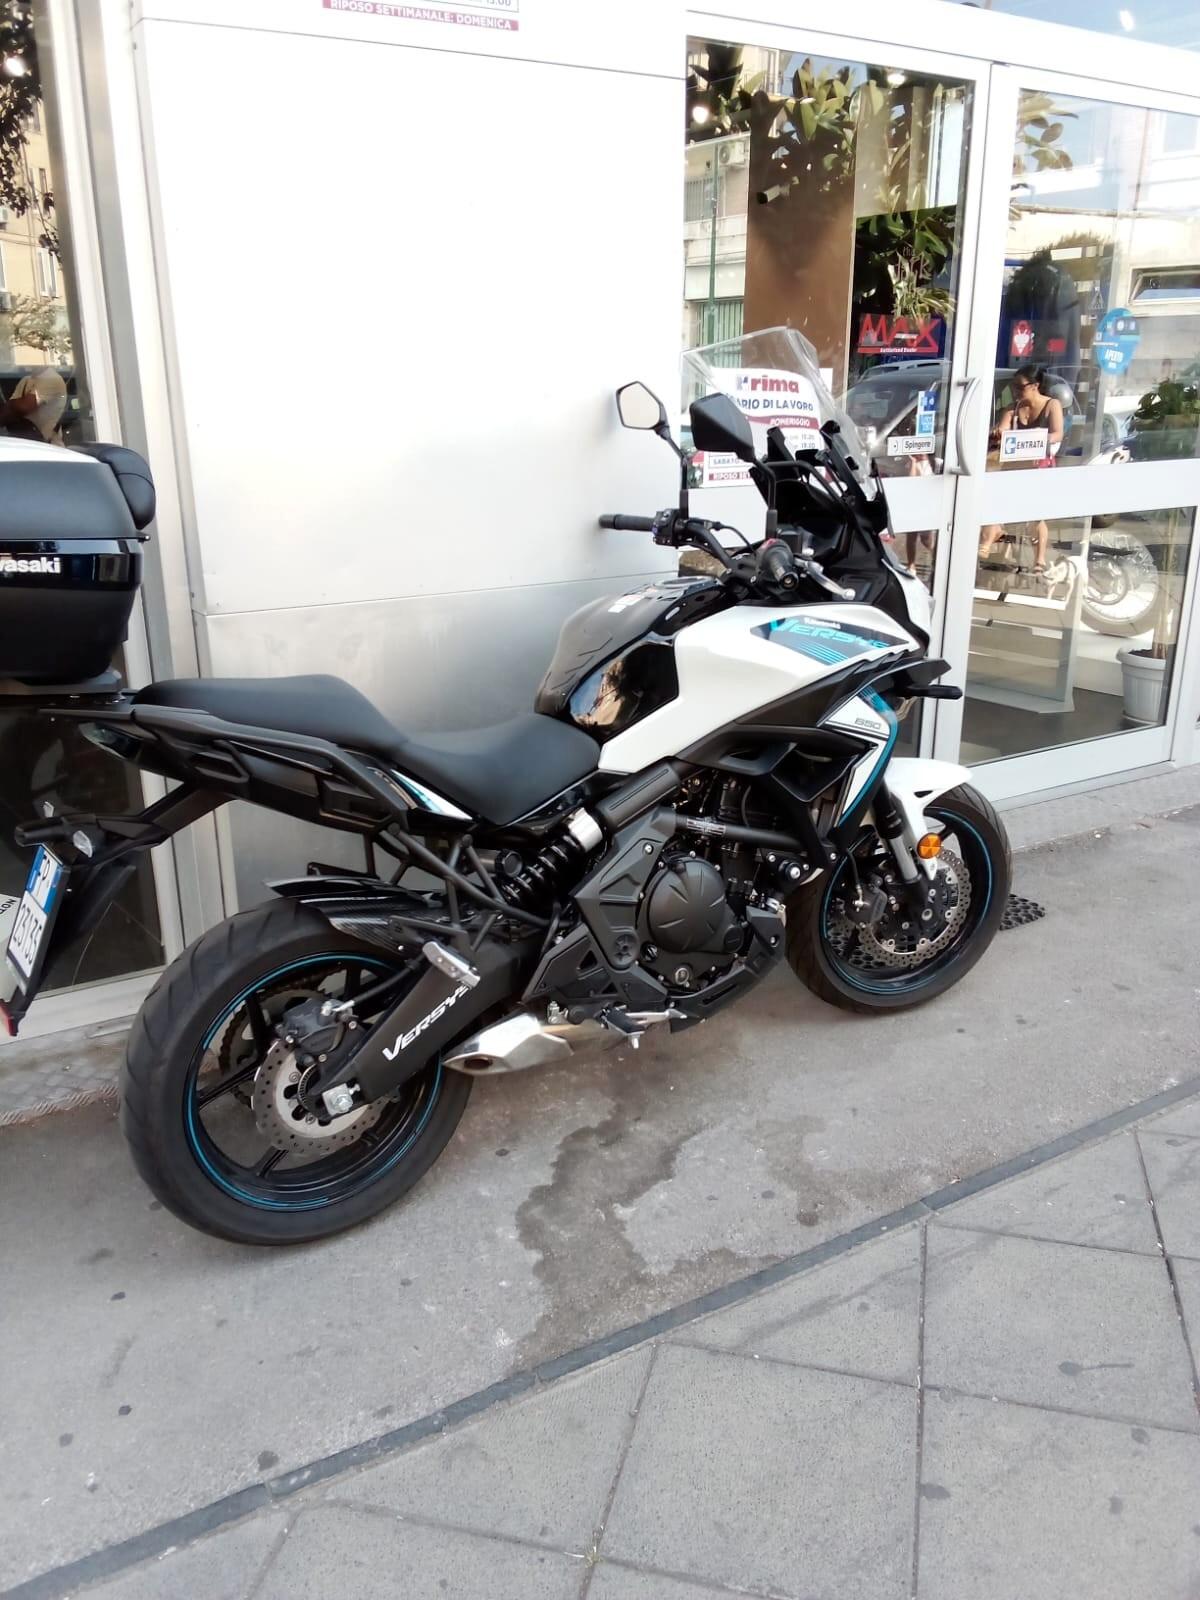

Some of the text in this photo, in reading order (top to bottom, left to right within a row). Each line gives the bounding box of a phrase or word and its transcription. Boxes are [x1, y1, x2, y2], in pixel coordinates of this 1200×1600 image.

[331, 0, 512, 30] RIPOSO SETTIMANALE: DOMENICA
[763, 399, 773, 408] DI
[776, 400, 814, 411] LAVORO
[1016, 440, 1044, 450] ENTRATA
[855, 717, 881, 730] 650
